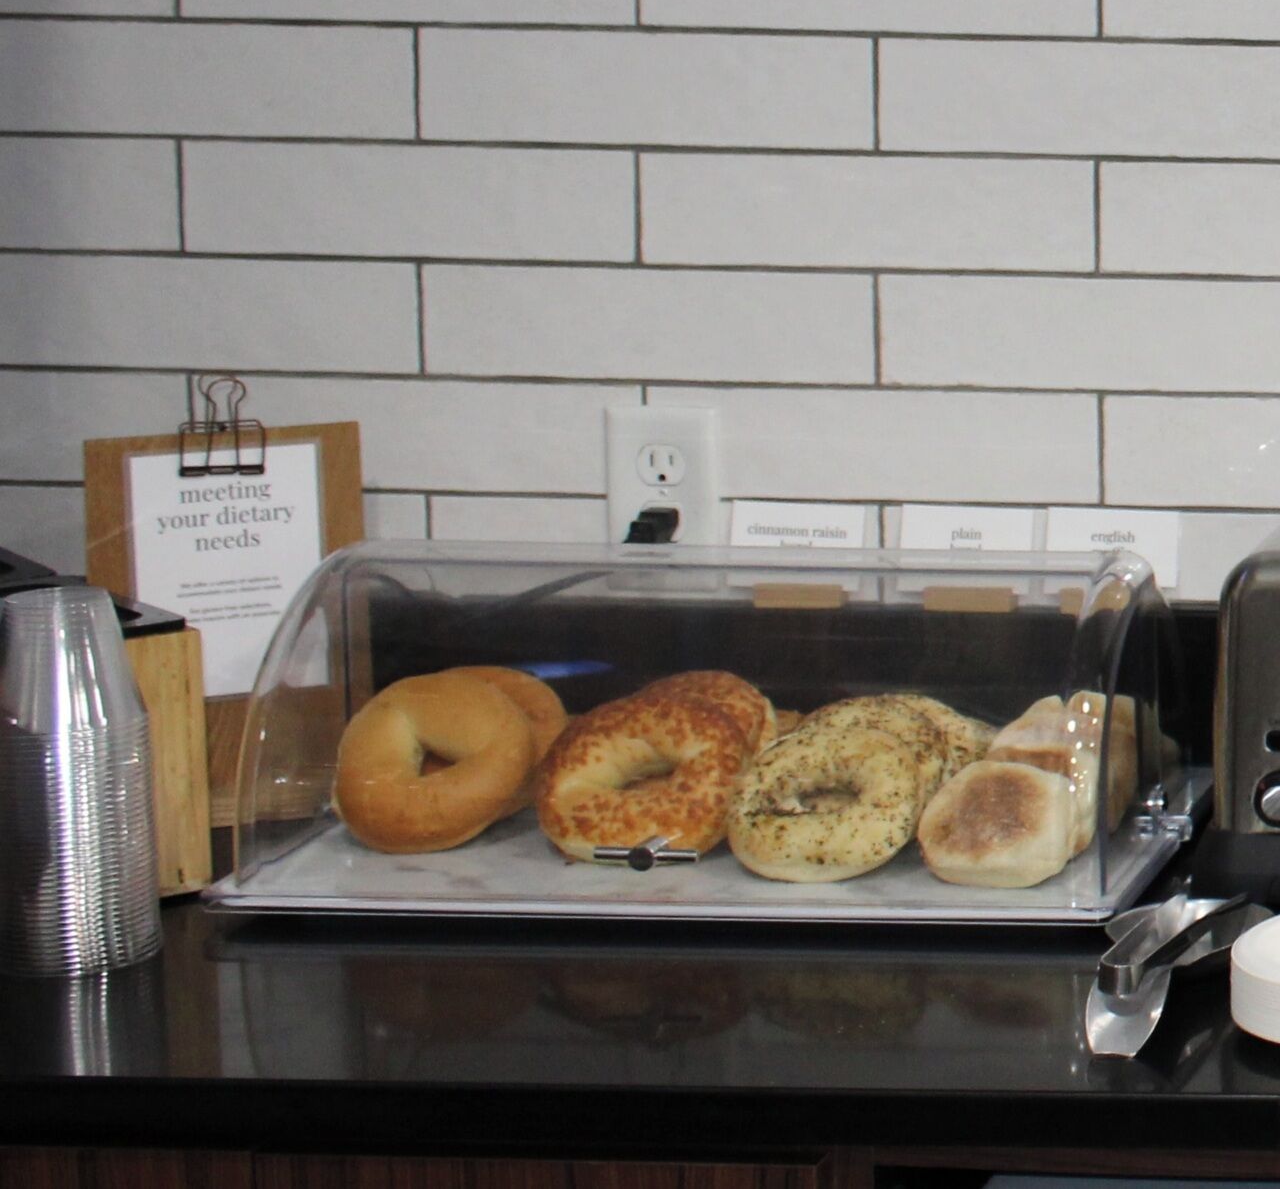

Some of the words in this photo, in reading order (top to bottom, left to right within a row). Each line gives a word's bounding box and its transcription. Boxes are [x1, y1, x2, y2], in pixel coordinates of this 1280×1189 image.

[179, 481, 271, 503] meeting
[157, 513, 209, 534] your
[216, 506, 294, 525] dietary
[195, 529, 260, 551] needs
[747, 523, 809, 537] cinnamon
[812, 527, 847, 539] raisin
[951, 527, 982, 541] plain
[1091, 530, 1135, 544] english
